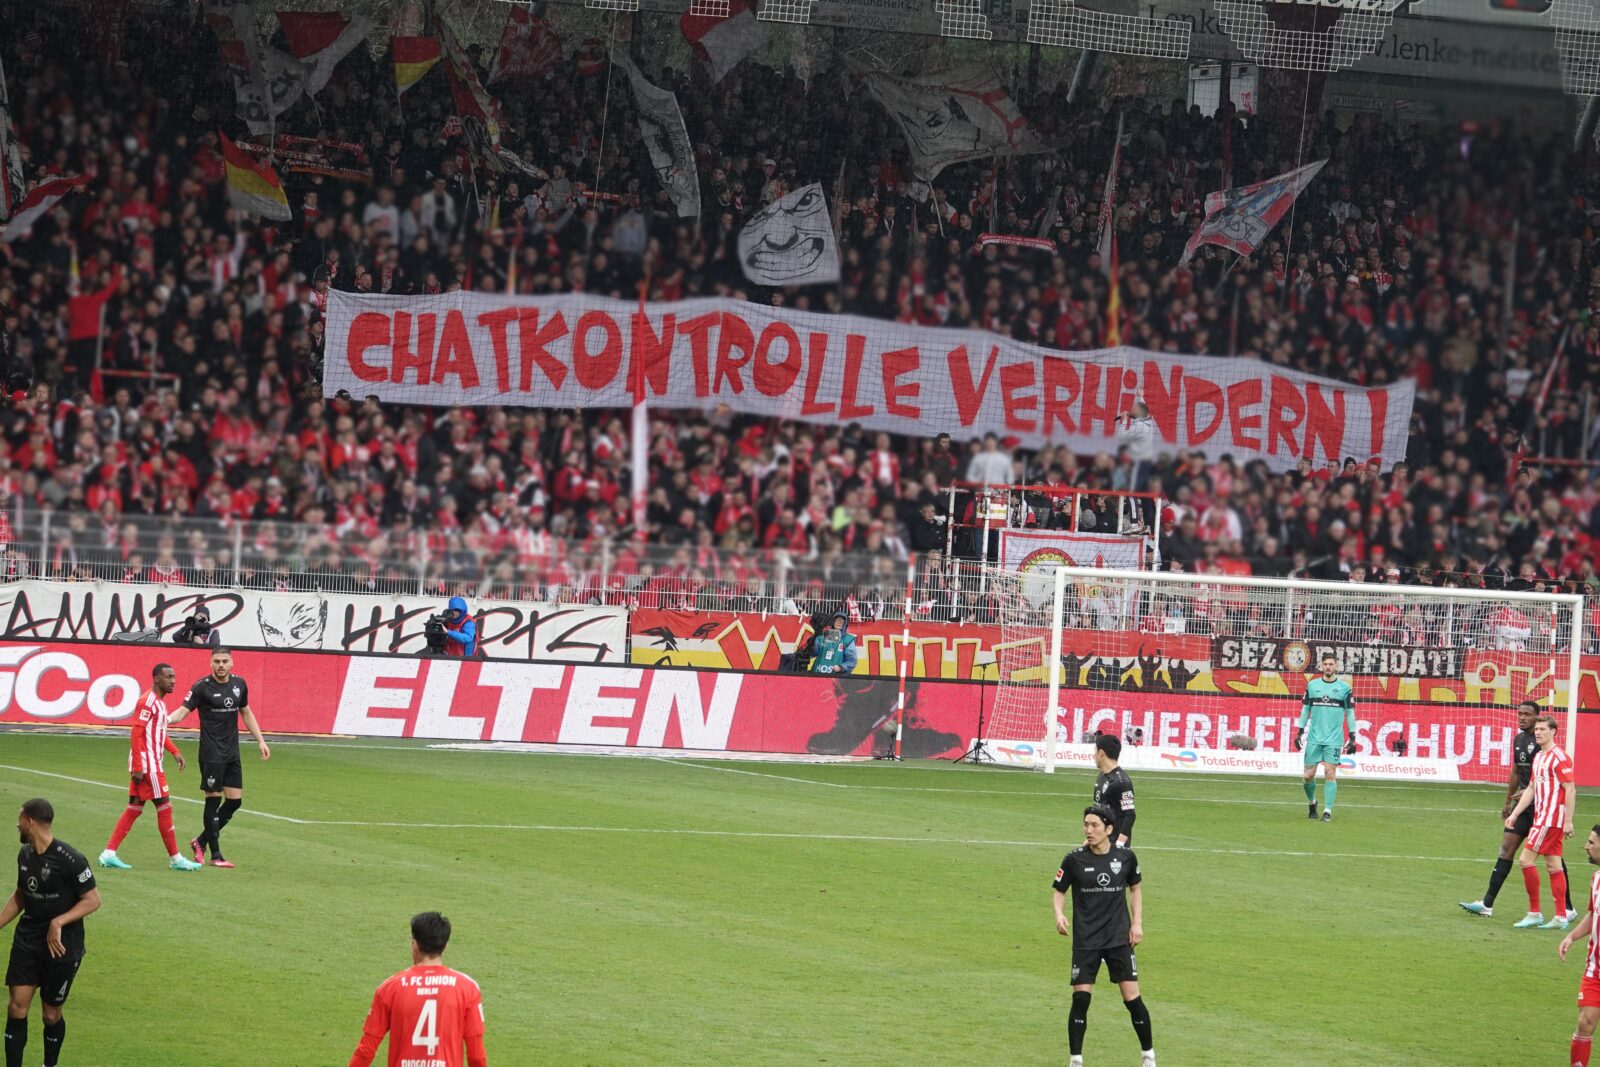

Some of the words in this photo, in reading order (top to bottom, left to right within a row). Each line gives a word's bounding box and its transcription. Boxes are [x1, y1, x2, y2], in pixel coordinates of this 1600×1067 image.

[1149, 5, 1235, 35] Lenke
[347, 306, 921, 420] CHATKONTROLLE
[1221, 640, 1284, 671] SEZ.
[332, 655, 744, 751] ELTEN
[1201, 755, 1279, 771] TotalEnergies
[1359, 762, 1438, 778] TotalEnergies
[401, 977, 408, 986] 1.
[411, 976, 422, 986] FC
[425, 975, 457, 987] UNION
[416, 987, 439, 996] BERLIN
[411, 998, 440, 1056] 4
